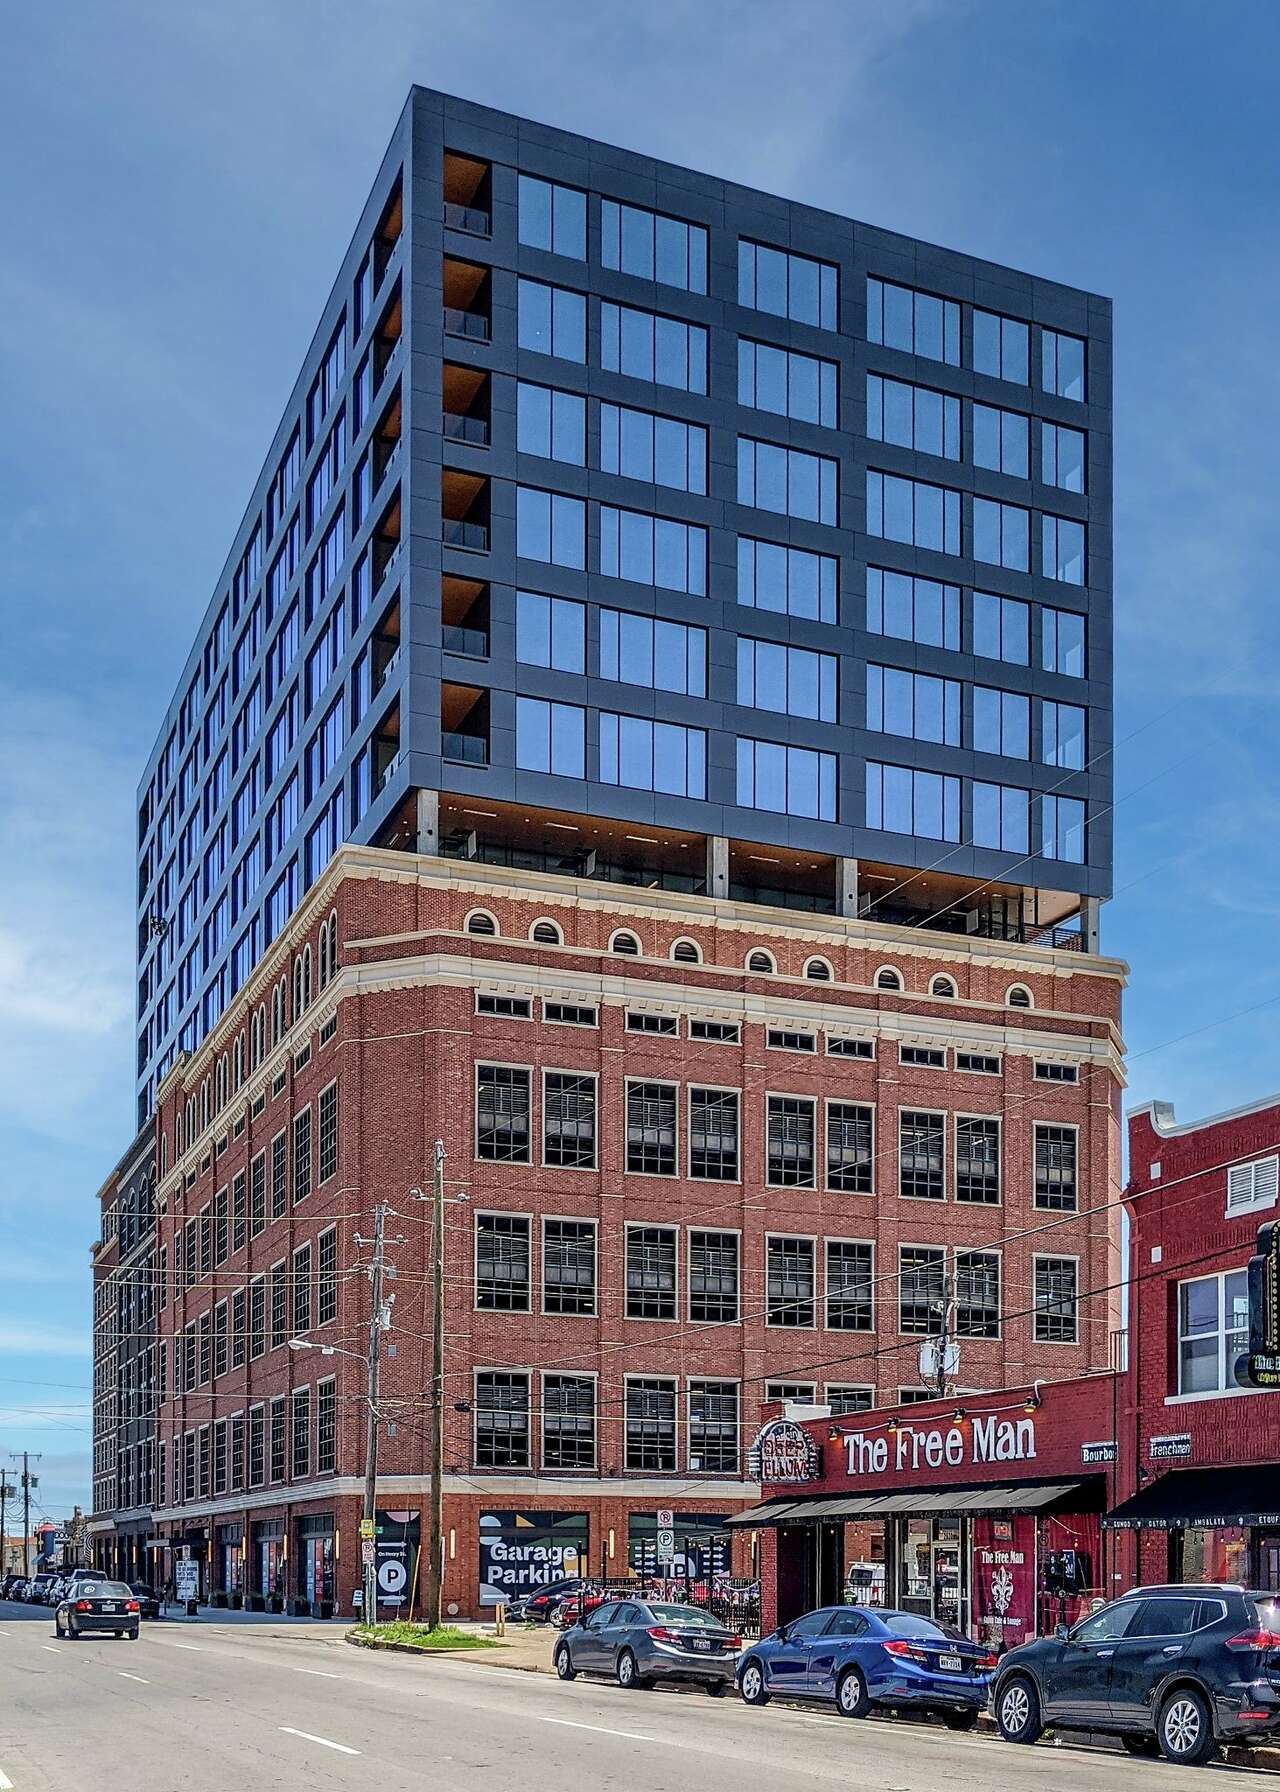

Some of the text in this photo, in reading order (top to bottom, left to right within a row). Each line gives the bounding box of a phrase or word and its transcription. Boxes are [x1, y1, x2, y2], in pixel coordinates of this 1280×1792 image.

[844, 1416, 1037, 1474] The Free Man
[490, 1542, 578, 1566] Garage
[982, 1550, 1024, 1564] The Free Man
[387, 1568, 399, 1584] P
